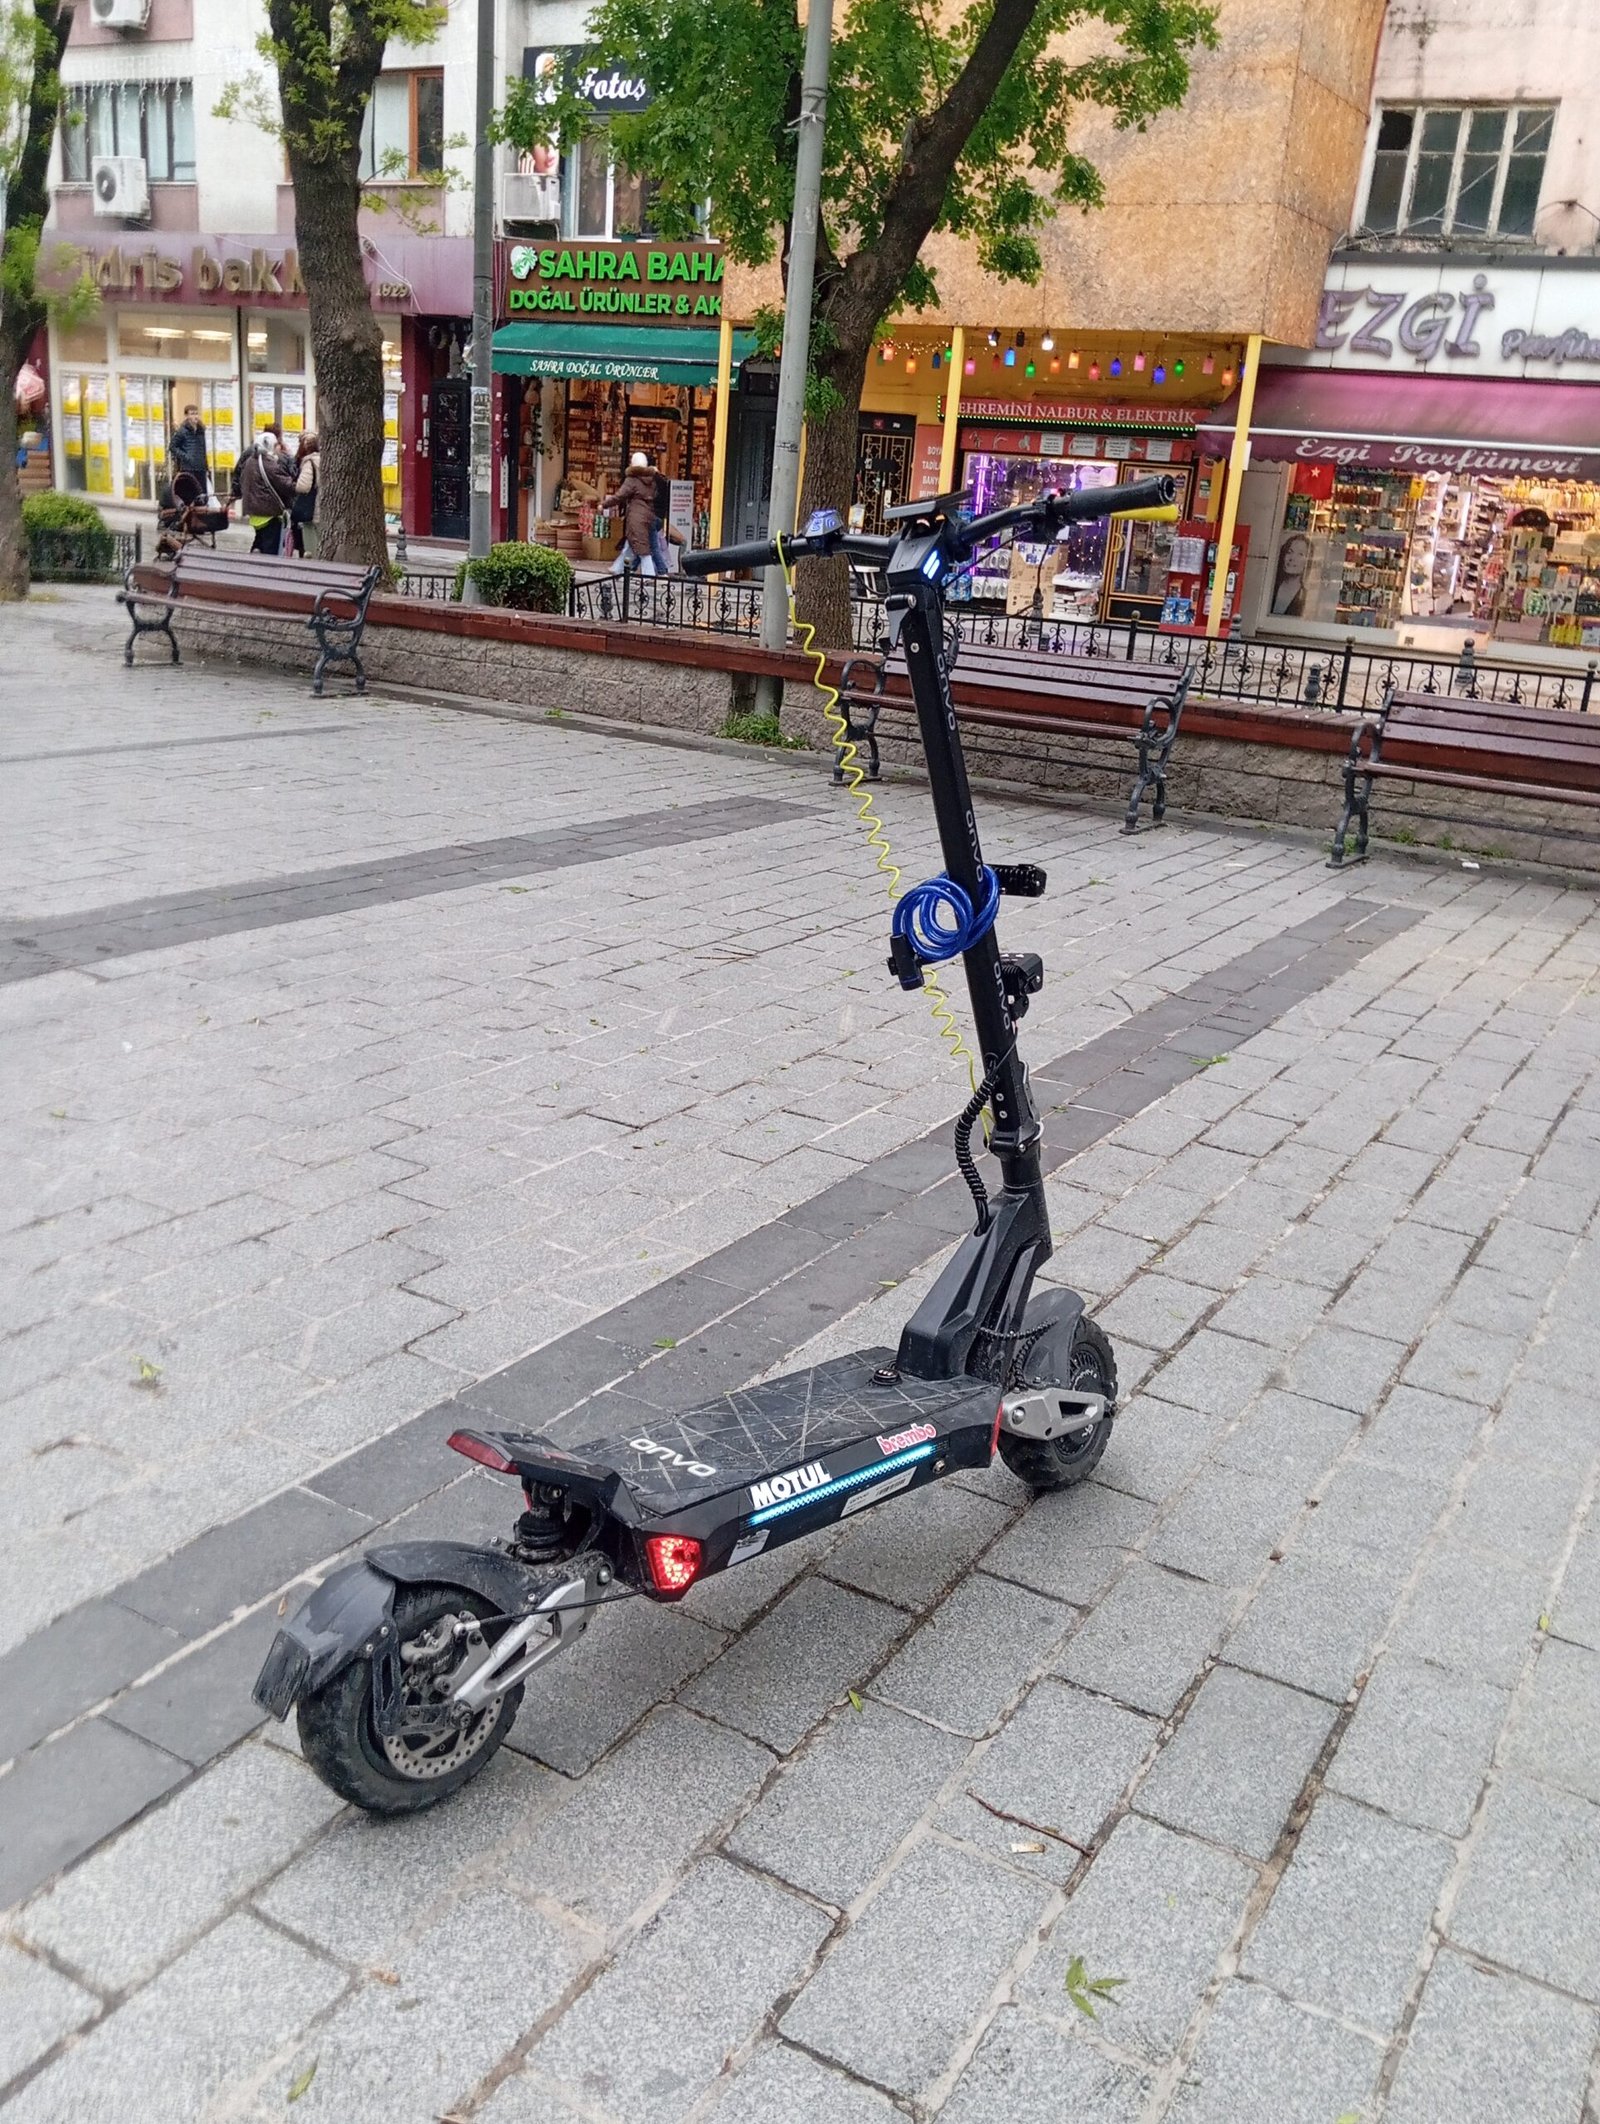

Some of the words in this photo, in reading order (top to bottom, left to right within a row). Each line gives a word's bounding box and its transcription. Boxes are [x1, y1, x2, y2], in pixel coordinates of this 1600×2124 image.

[191, 247, 306, 293] bakk
[538, 249, 640, 280] SAHRA
[646, 251, 724, 282] BAHA
[510, 286, 576, 311] DOĞAL
[580, 287, 671, 314] ÜRÜNLER
[675, 295, 690, 313] &
[693, 296, 722, 316] AK
[1315, 273, 1495, 362] EZGİ
[1501, 327, 1600, 365] Parfü
[530, 359, 563, 373] SAHRA
[566, 361, 602, 377] DOĞAL
[958, 401, 1032, 417] EHREMİNİ
[1035, 404, 1098, 421] NALBUR
[1101, 408, 1112, 421] &
[1115, 408, 1197, 425] ELEKTRİK
[1295, 438, 1371, 466] Ezgi
[1389, 443, 1583, 475] Parfümeri
[876, 1423, 937, 1456] brembo
[750, 1462, 833, 1511] MOTUL
